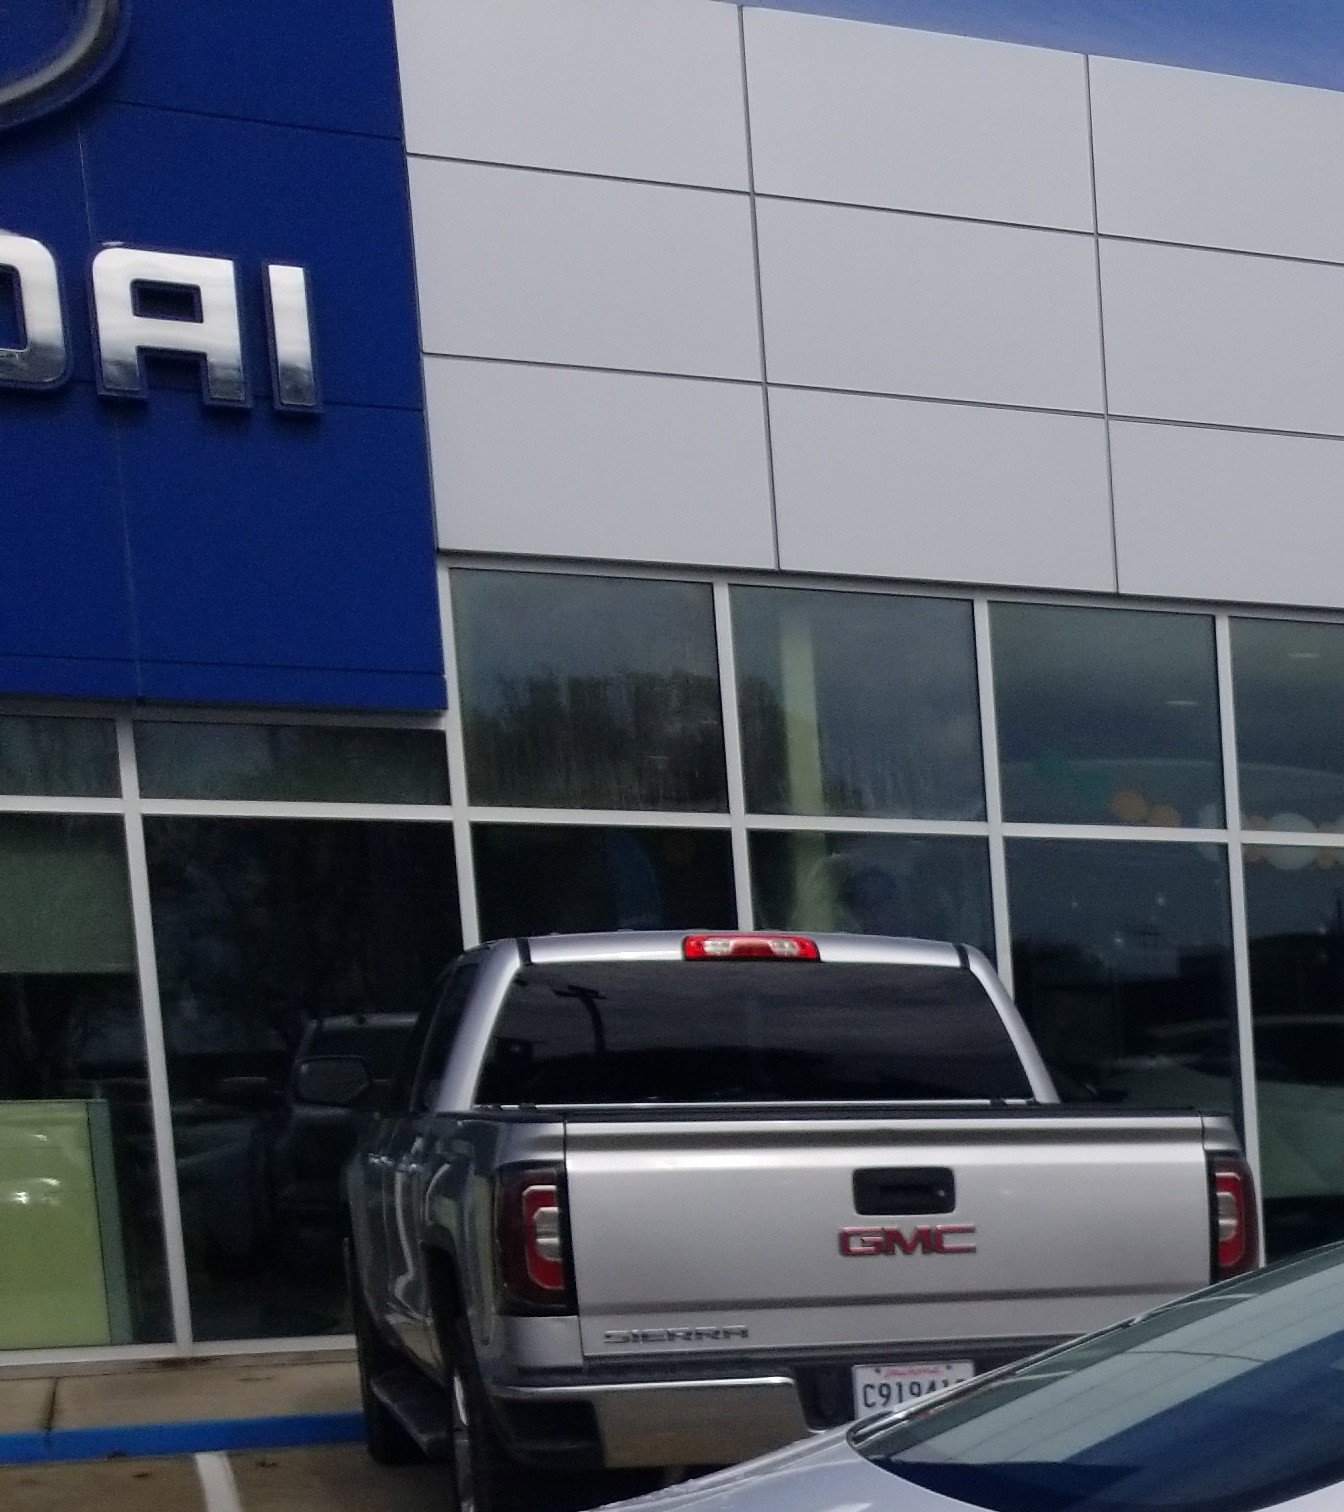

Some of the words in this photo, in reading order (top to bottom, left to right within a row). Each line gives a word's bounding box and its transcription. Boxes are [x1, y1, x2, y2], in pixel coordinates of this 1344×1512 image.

[840, 1224, 978, 1257] GMC
[603, 1323, 750, 1345] SIERRA
[862, 1378, 966, 1409] C919
